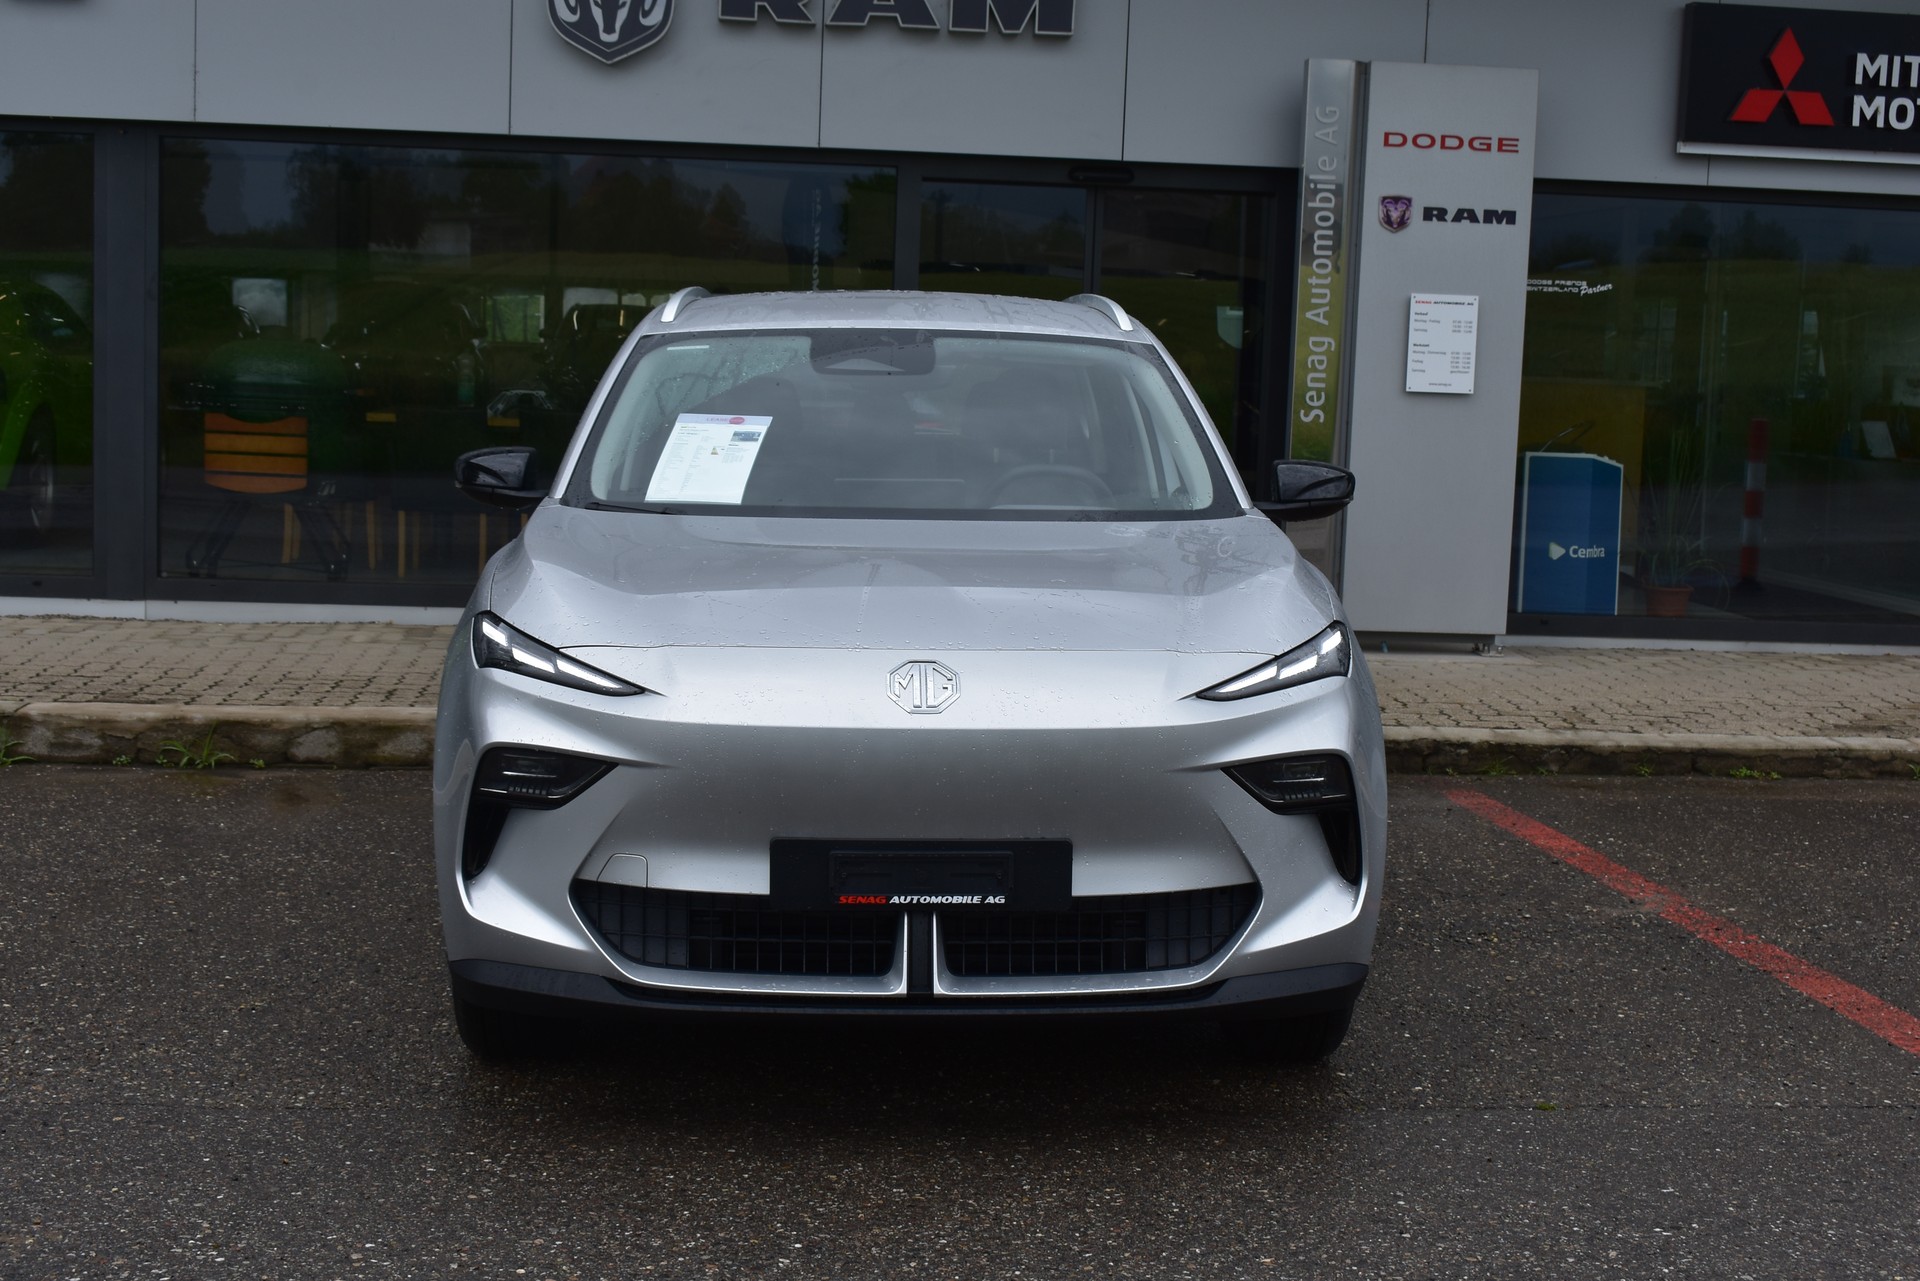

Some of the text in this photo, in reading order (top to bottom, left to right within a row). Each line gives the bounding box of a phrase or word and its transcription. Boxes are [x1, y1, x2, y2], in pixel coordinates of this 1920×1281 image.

[1851, 94, 1920, 131] MO
[1383, 131, 1520, 154] DODGE
[1422, 206, 1517, 225] RAM
[1300, 105, 1340, 423] Senag Automobile AG
[1579, 283, 1613, 297] Partner
[1569, 544, 1606, 558] Cembra
[893, 663, 954, 709] MG
[838, 895, 1006, 905] SENAG AUTOMOBILE AG
